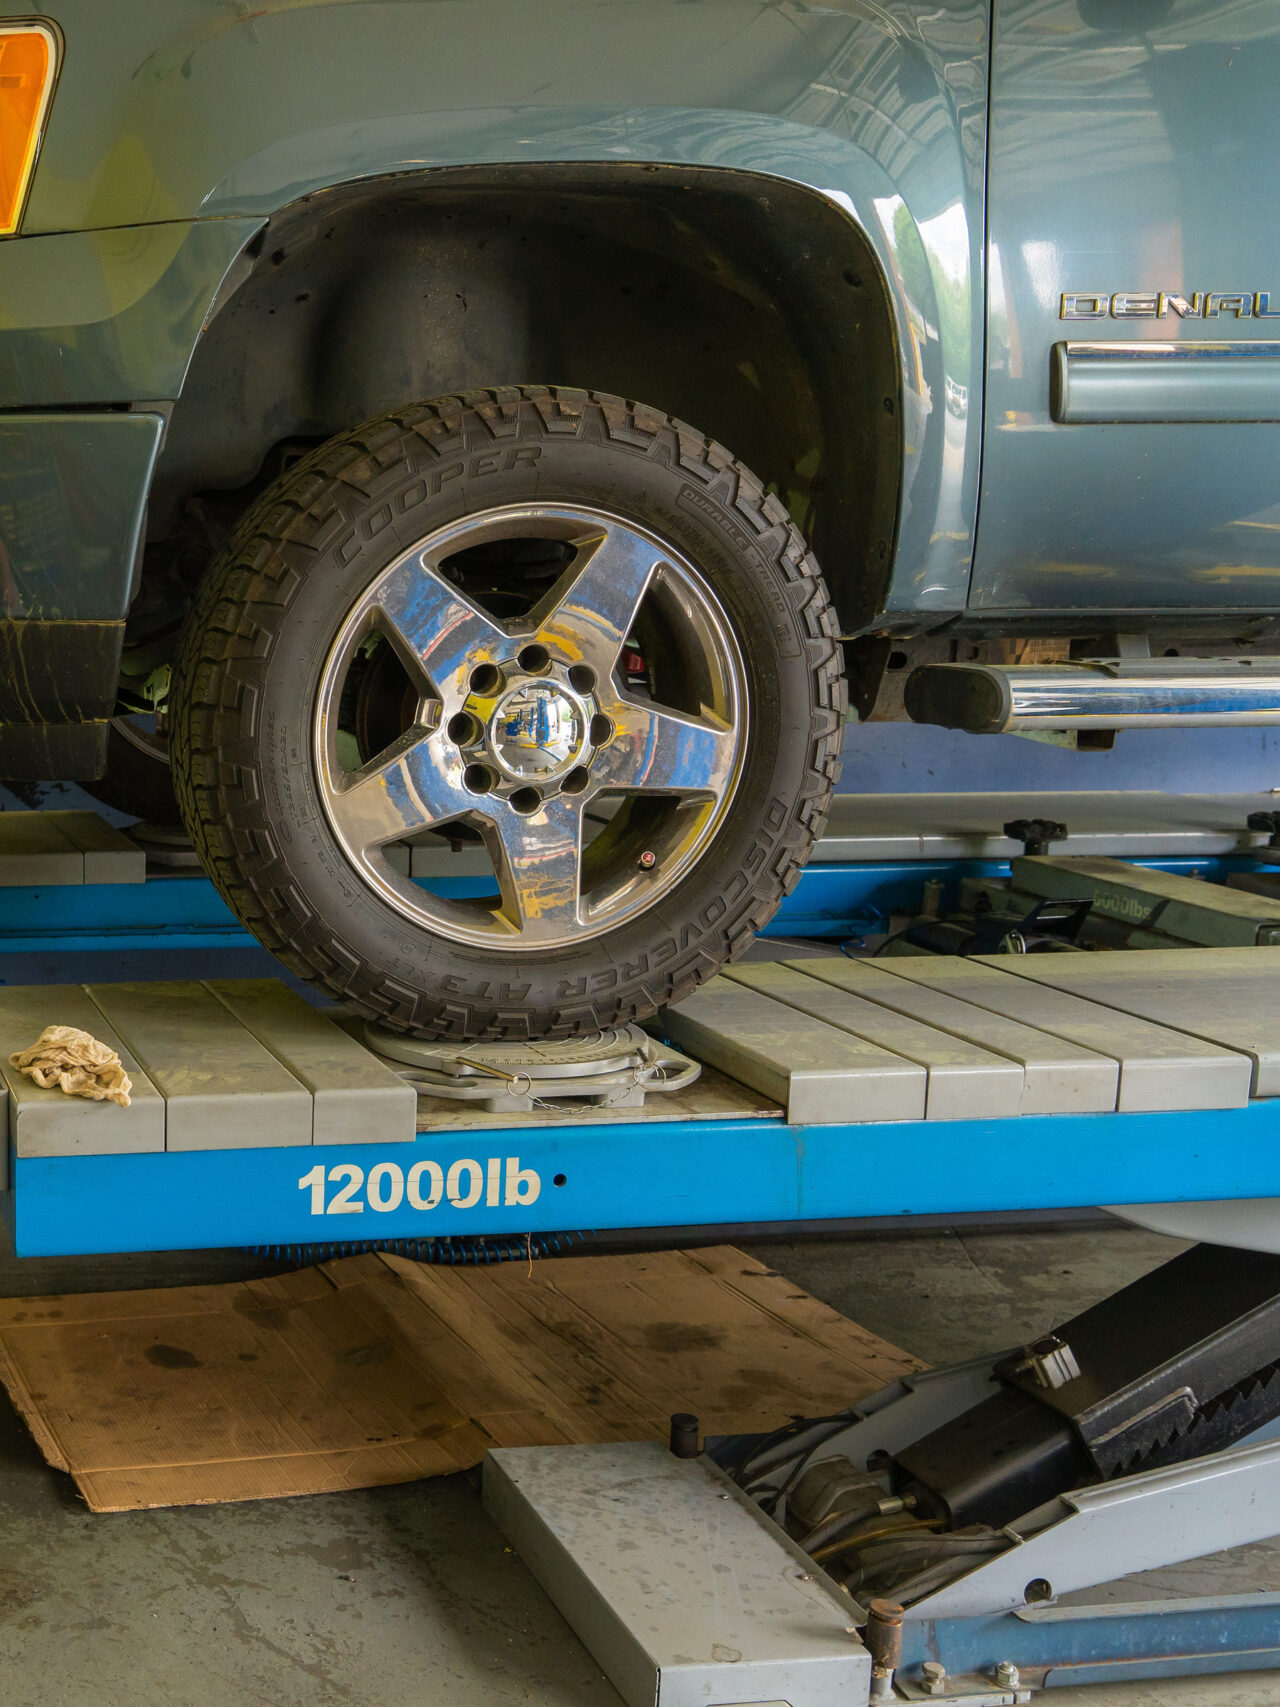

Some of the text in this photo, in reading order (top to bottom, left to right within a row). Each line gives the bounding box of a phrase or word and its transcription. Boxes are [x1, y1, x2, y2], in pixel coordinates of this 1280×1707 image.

[334, 446, 543, 569] COOPER
[681, 487, 748, 549] DURABLE
[556, 797, 789, 999] DISCOVERER
[1093, 889, 1151, 920] 6000lbs
[439, 974, 532, 1001] AT3
[297, 1157, 542, 1216] 12000lb
